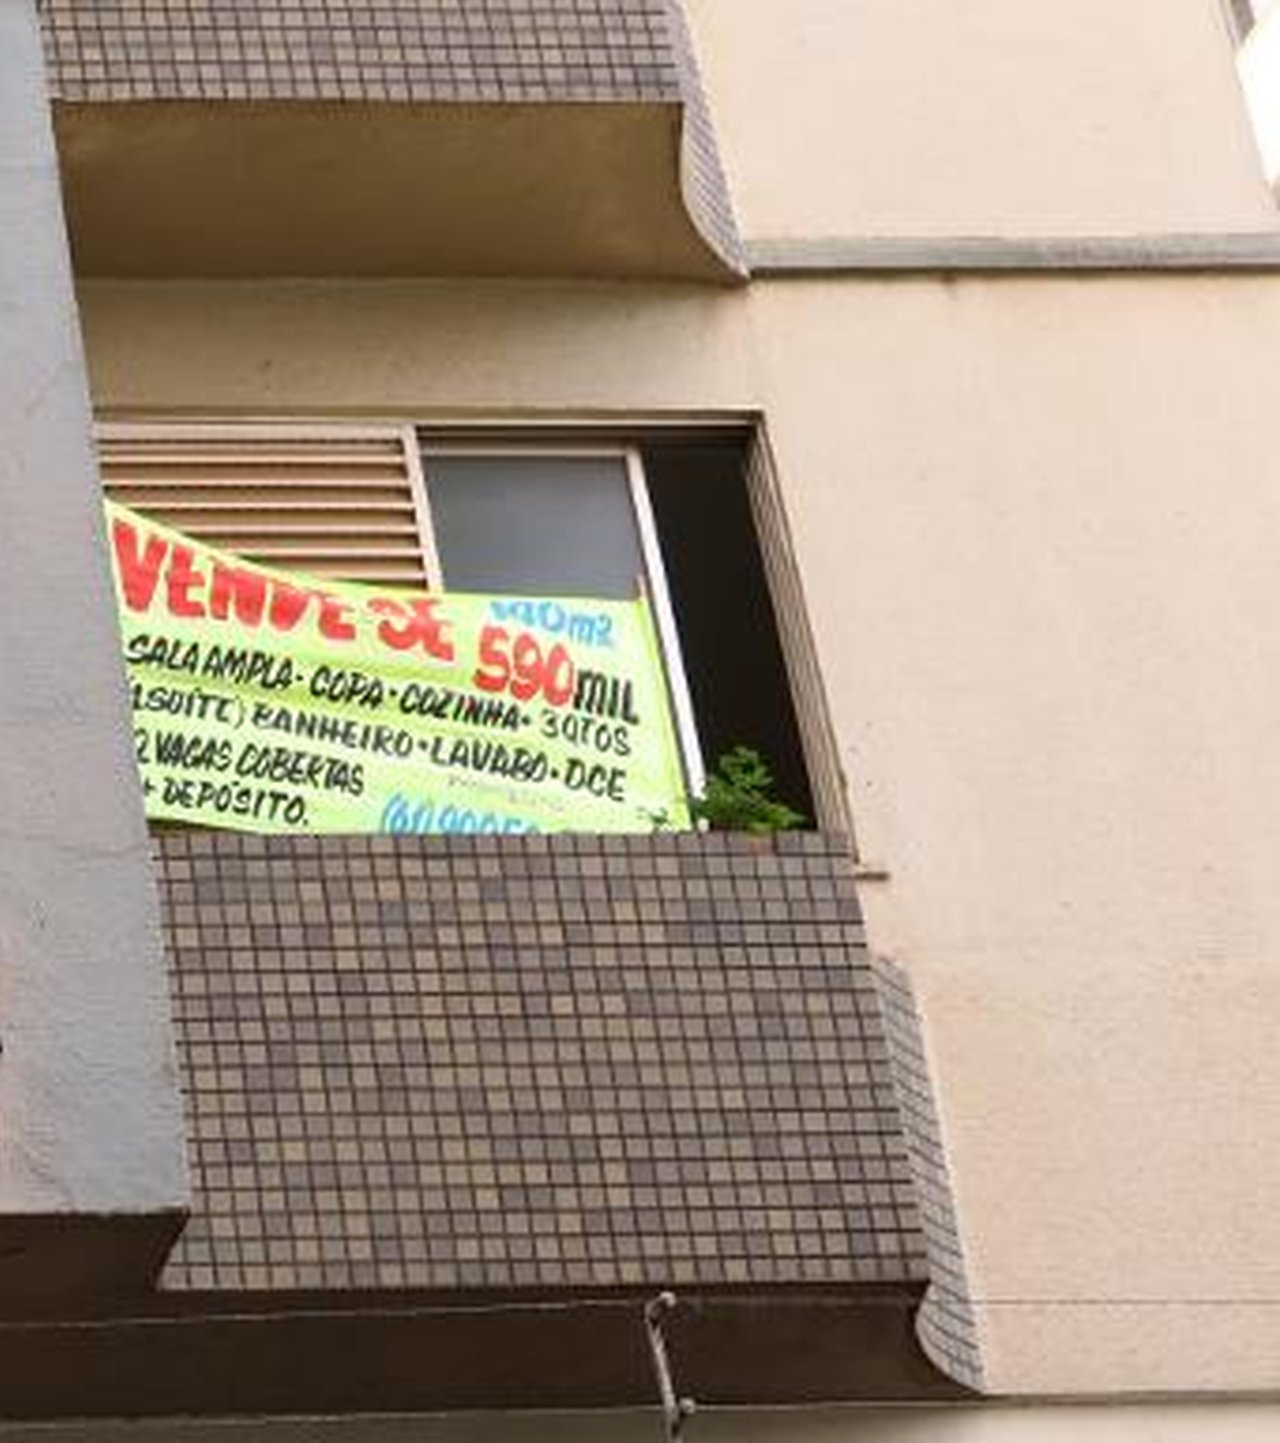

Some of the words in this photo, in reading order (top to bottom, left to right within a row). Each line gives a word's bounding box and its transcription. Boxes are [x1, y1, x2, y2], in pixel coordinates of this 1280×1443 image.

[112, 516, 357, 641] VENDE
[367, 596, 454, 662] SE
[127, 634, 198, 678] SALA
[473, 625, 574, 707] 590
[155, 730, 233, 771] VAGAS
[235, 742, 365, 797] COBERTAS
[564, 756, 626, 802] DCE
